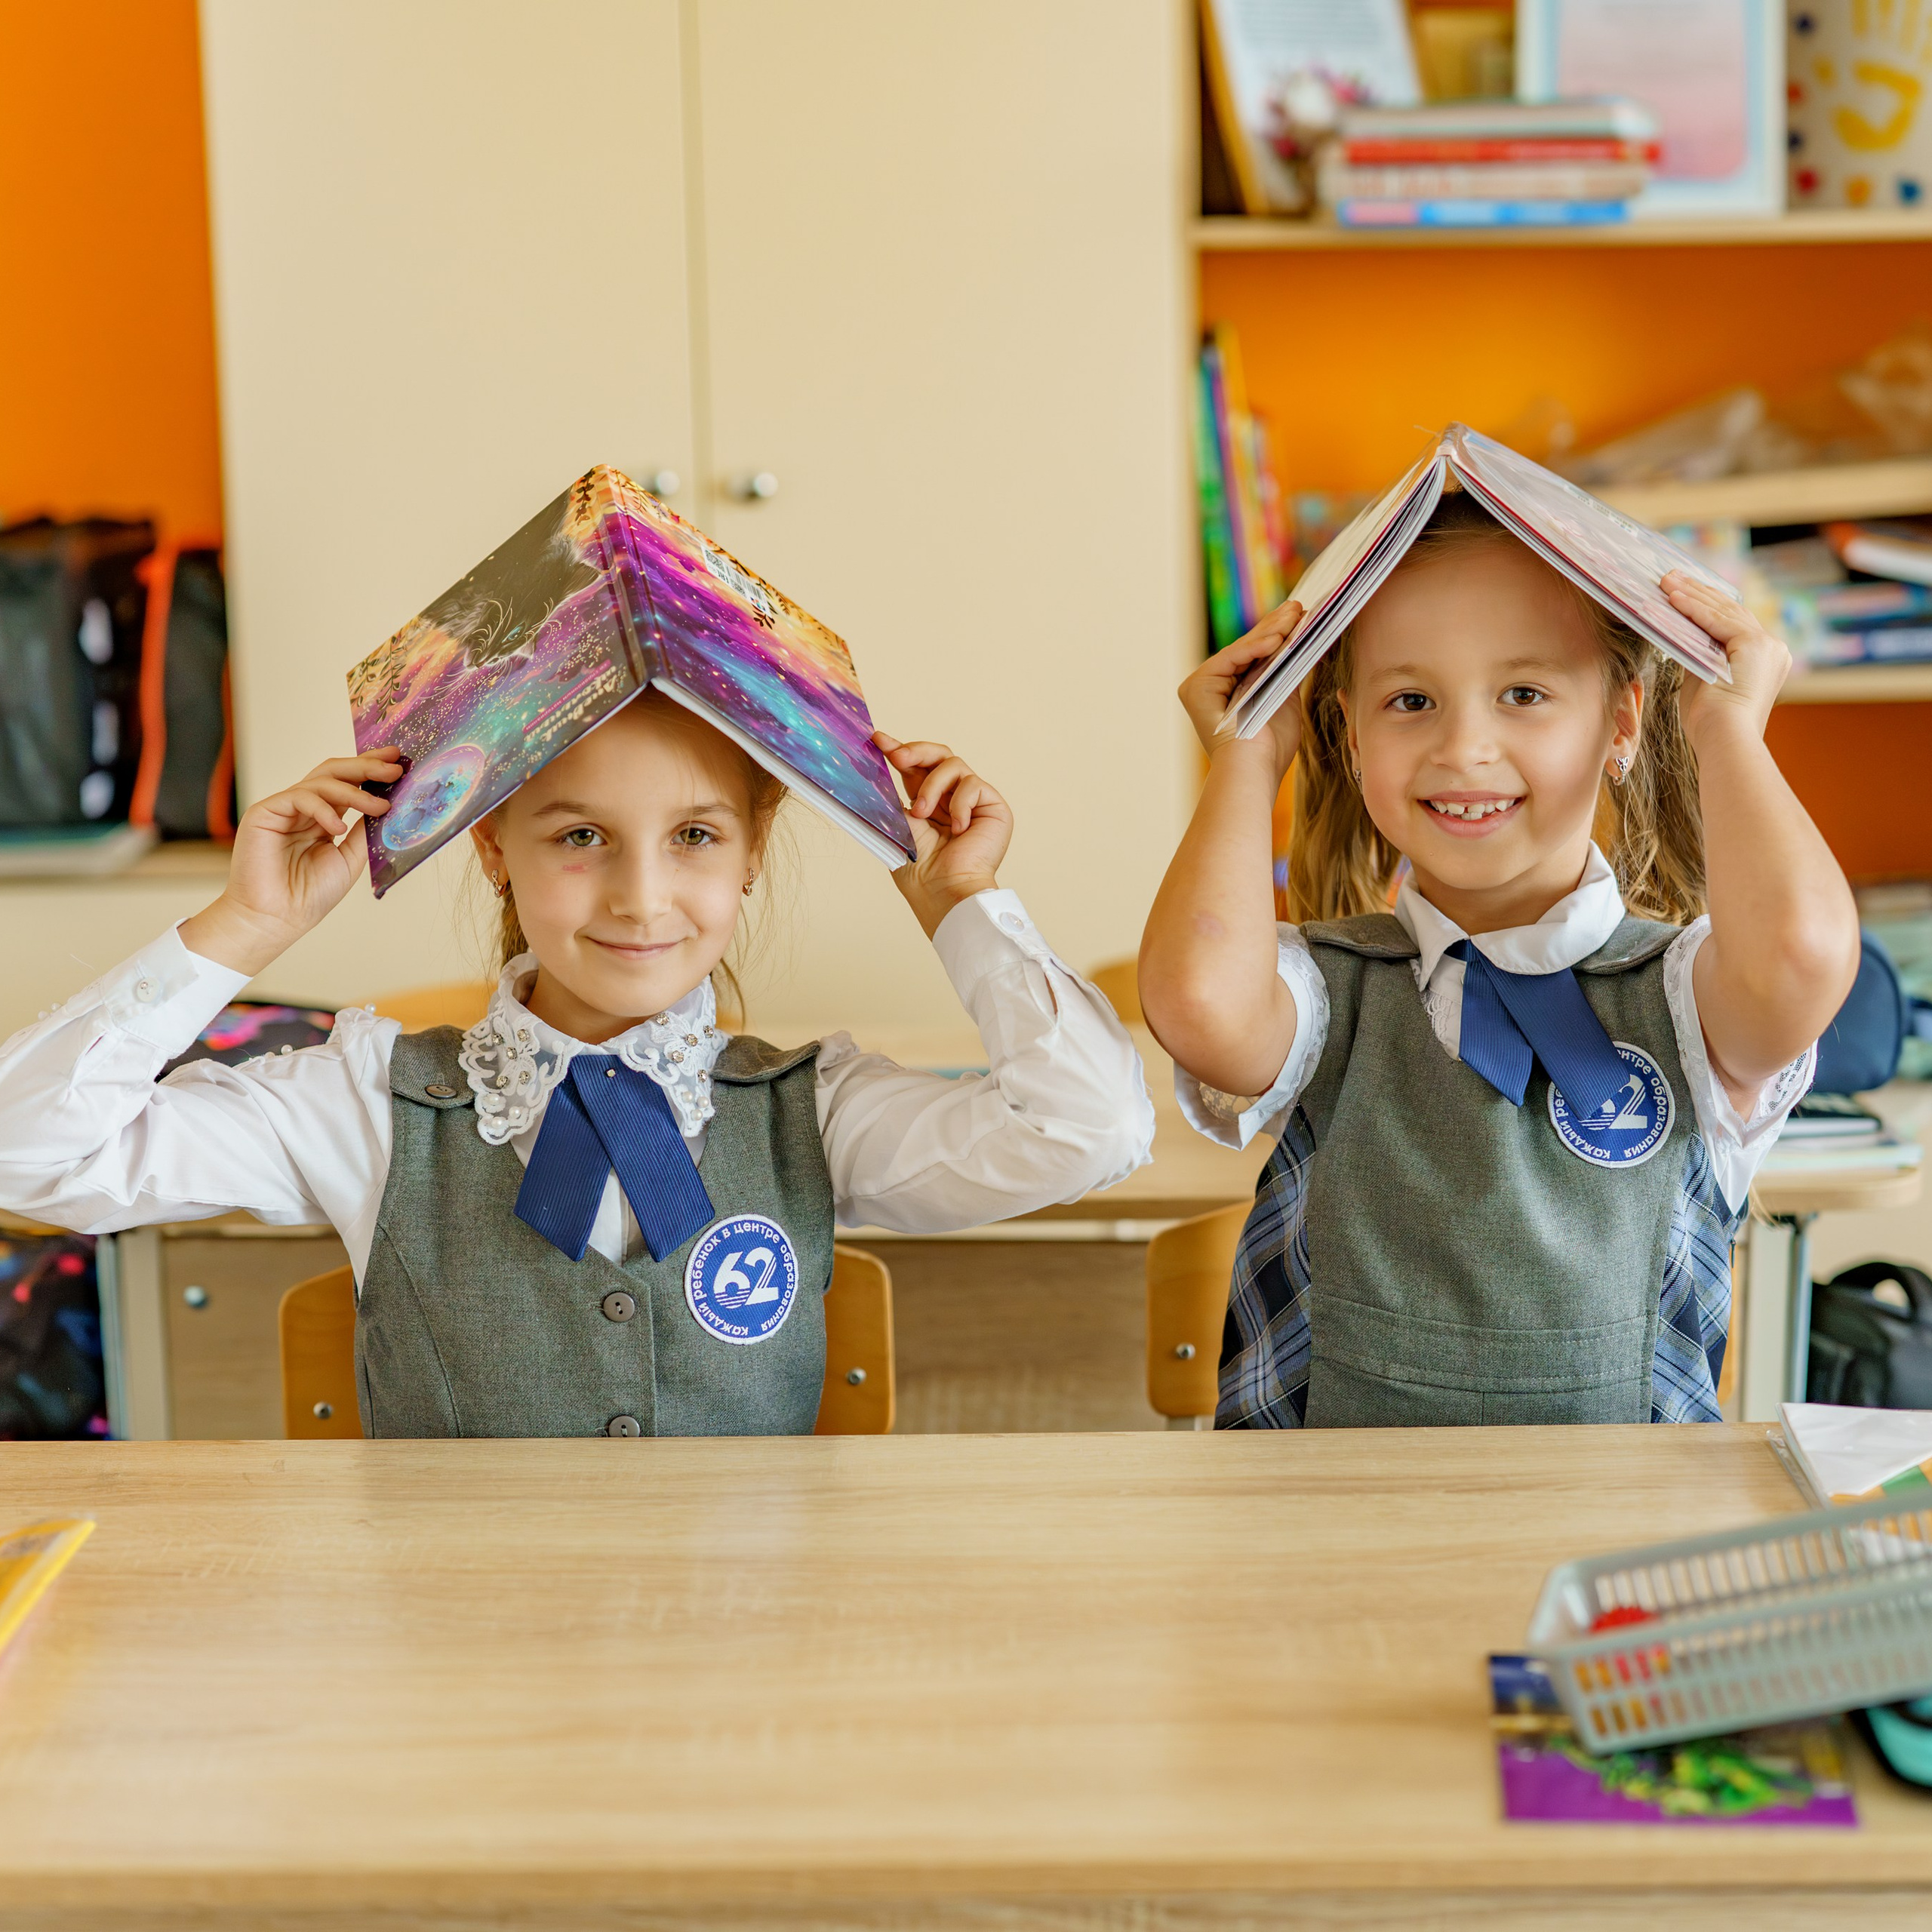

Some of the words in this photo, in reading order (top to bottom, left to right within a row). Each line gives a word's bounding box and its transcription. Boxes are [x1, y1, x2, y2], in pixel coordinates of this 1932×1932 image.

[1558, 1121, 1611, 1159] каждый
[1624, 1078, 1667, 1158] образования
[722, 1227, 731, 1238] в
[734, 1222, 780, 1244] центре
[692, 1236, 721, 1300] ребенок
[713, 1247, 779, 1309] 62
[761, 1244, 794, 1331] образования
[697, 1303, 749, 1336] каждый
